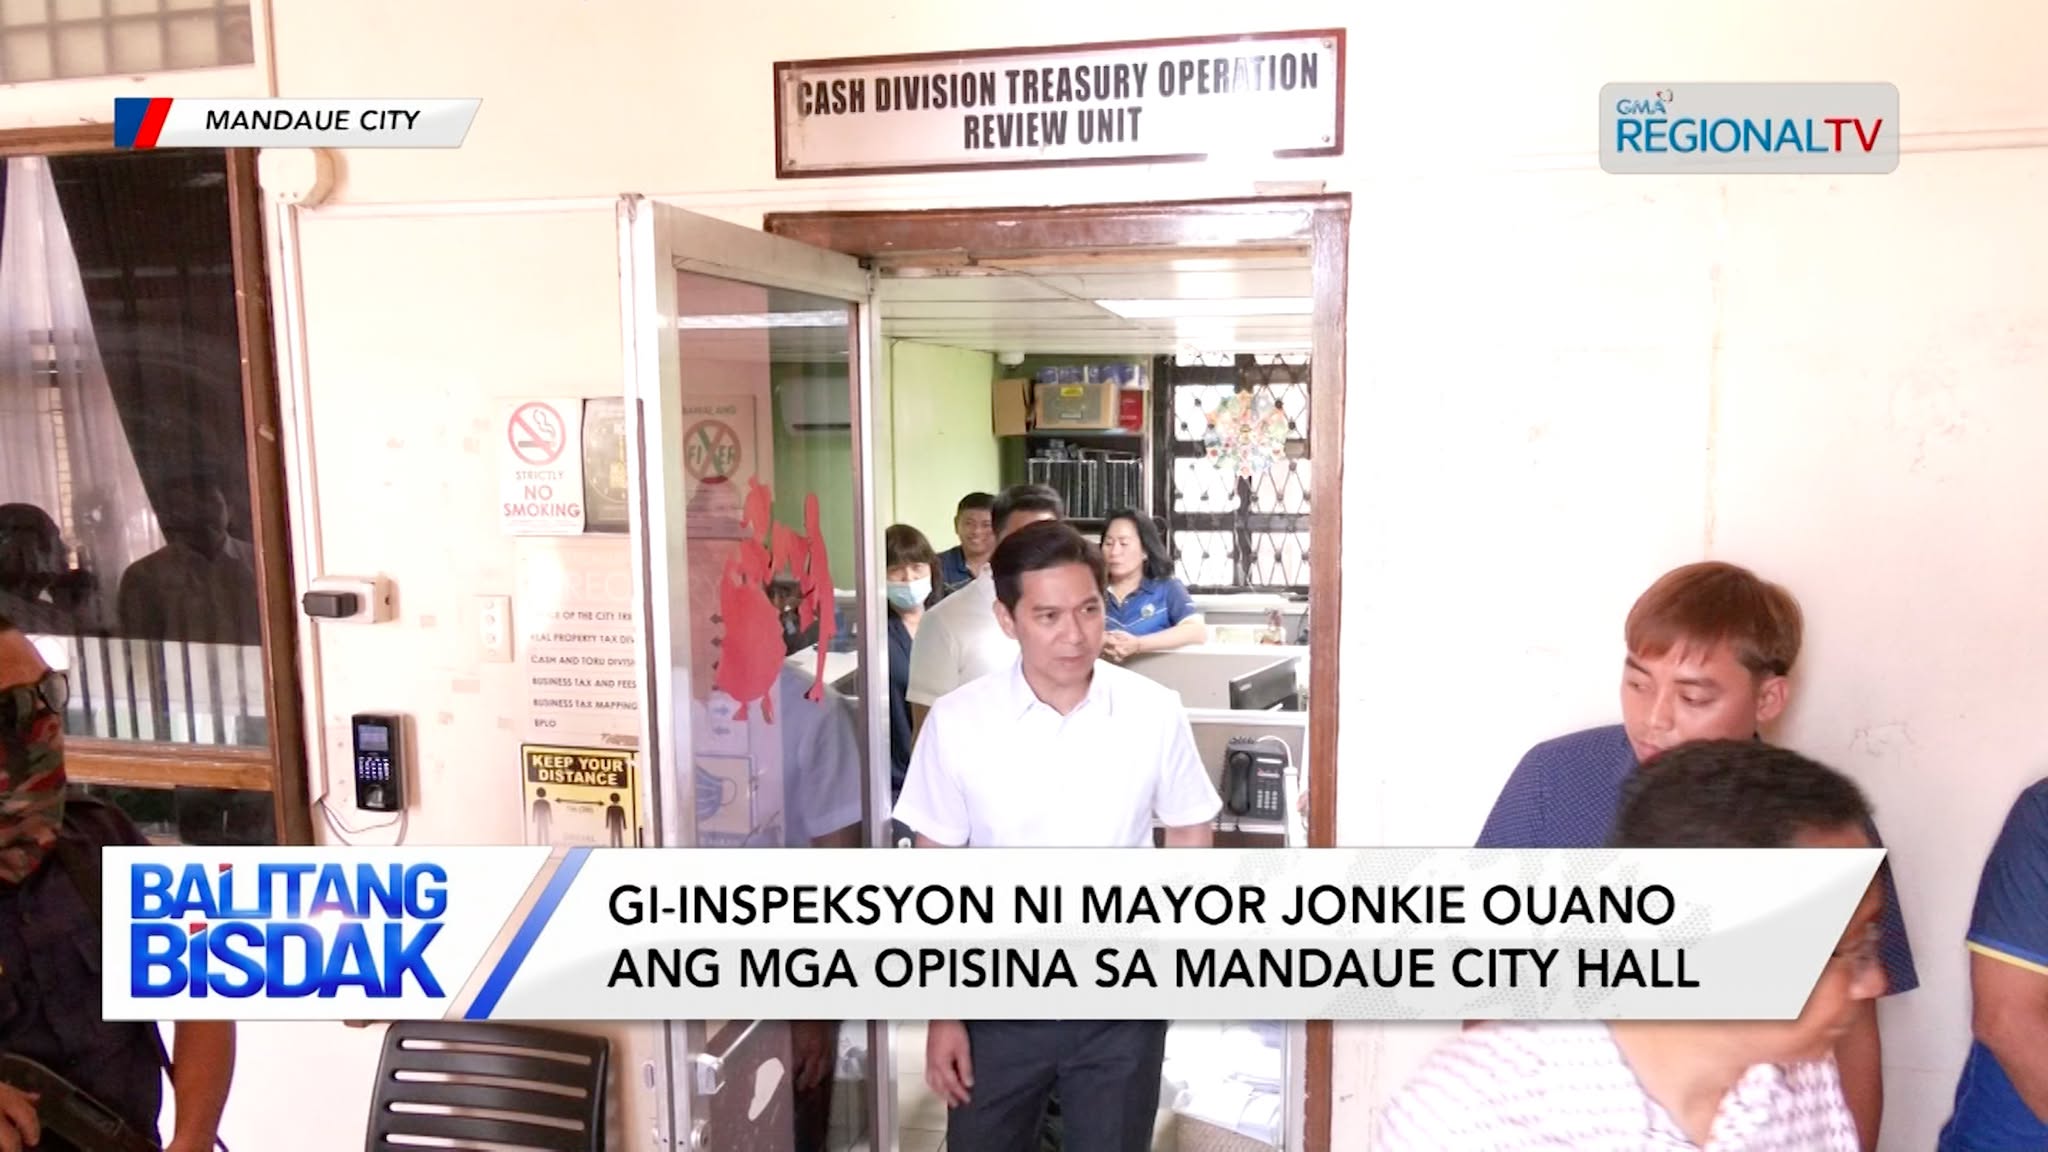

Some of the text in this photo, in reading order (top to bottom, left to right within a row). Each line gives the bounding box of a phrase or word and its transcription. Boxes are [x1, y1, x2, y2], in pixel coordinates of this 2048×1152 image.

[797, 52, 1318, 117] CASH DIVISION TREASURY OPERATION
[964, 106, 1143, 150] REVIEW UNIT
[515, 470, 565, 481] STRICTLY
[524, 485, 553, 501] NO
[503, 502, 581, 518] SMOKING
[562, 611, 576, 621] OF
[578, 611, 593, 621] THE
[595, 612, 615, 622] CITY
[553, 634, 597, 644] PROPERTY
[599, 635, 618, 645] TAX
[530, 655, 557, 665] CASH
[558, 656, 580, 666] AND
[532, 677, 637, 690] BUSINESS TAX AND FEES
[533, 699, 638, 711] BUSINESS TAX MAPPING
[534, 718, 557, 728] BPLO
[532, 754, 624, 772] KEEP YOUR
[538, 769, 619, 786] DISTANCE
